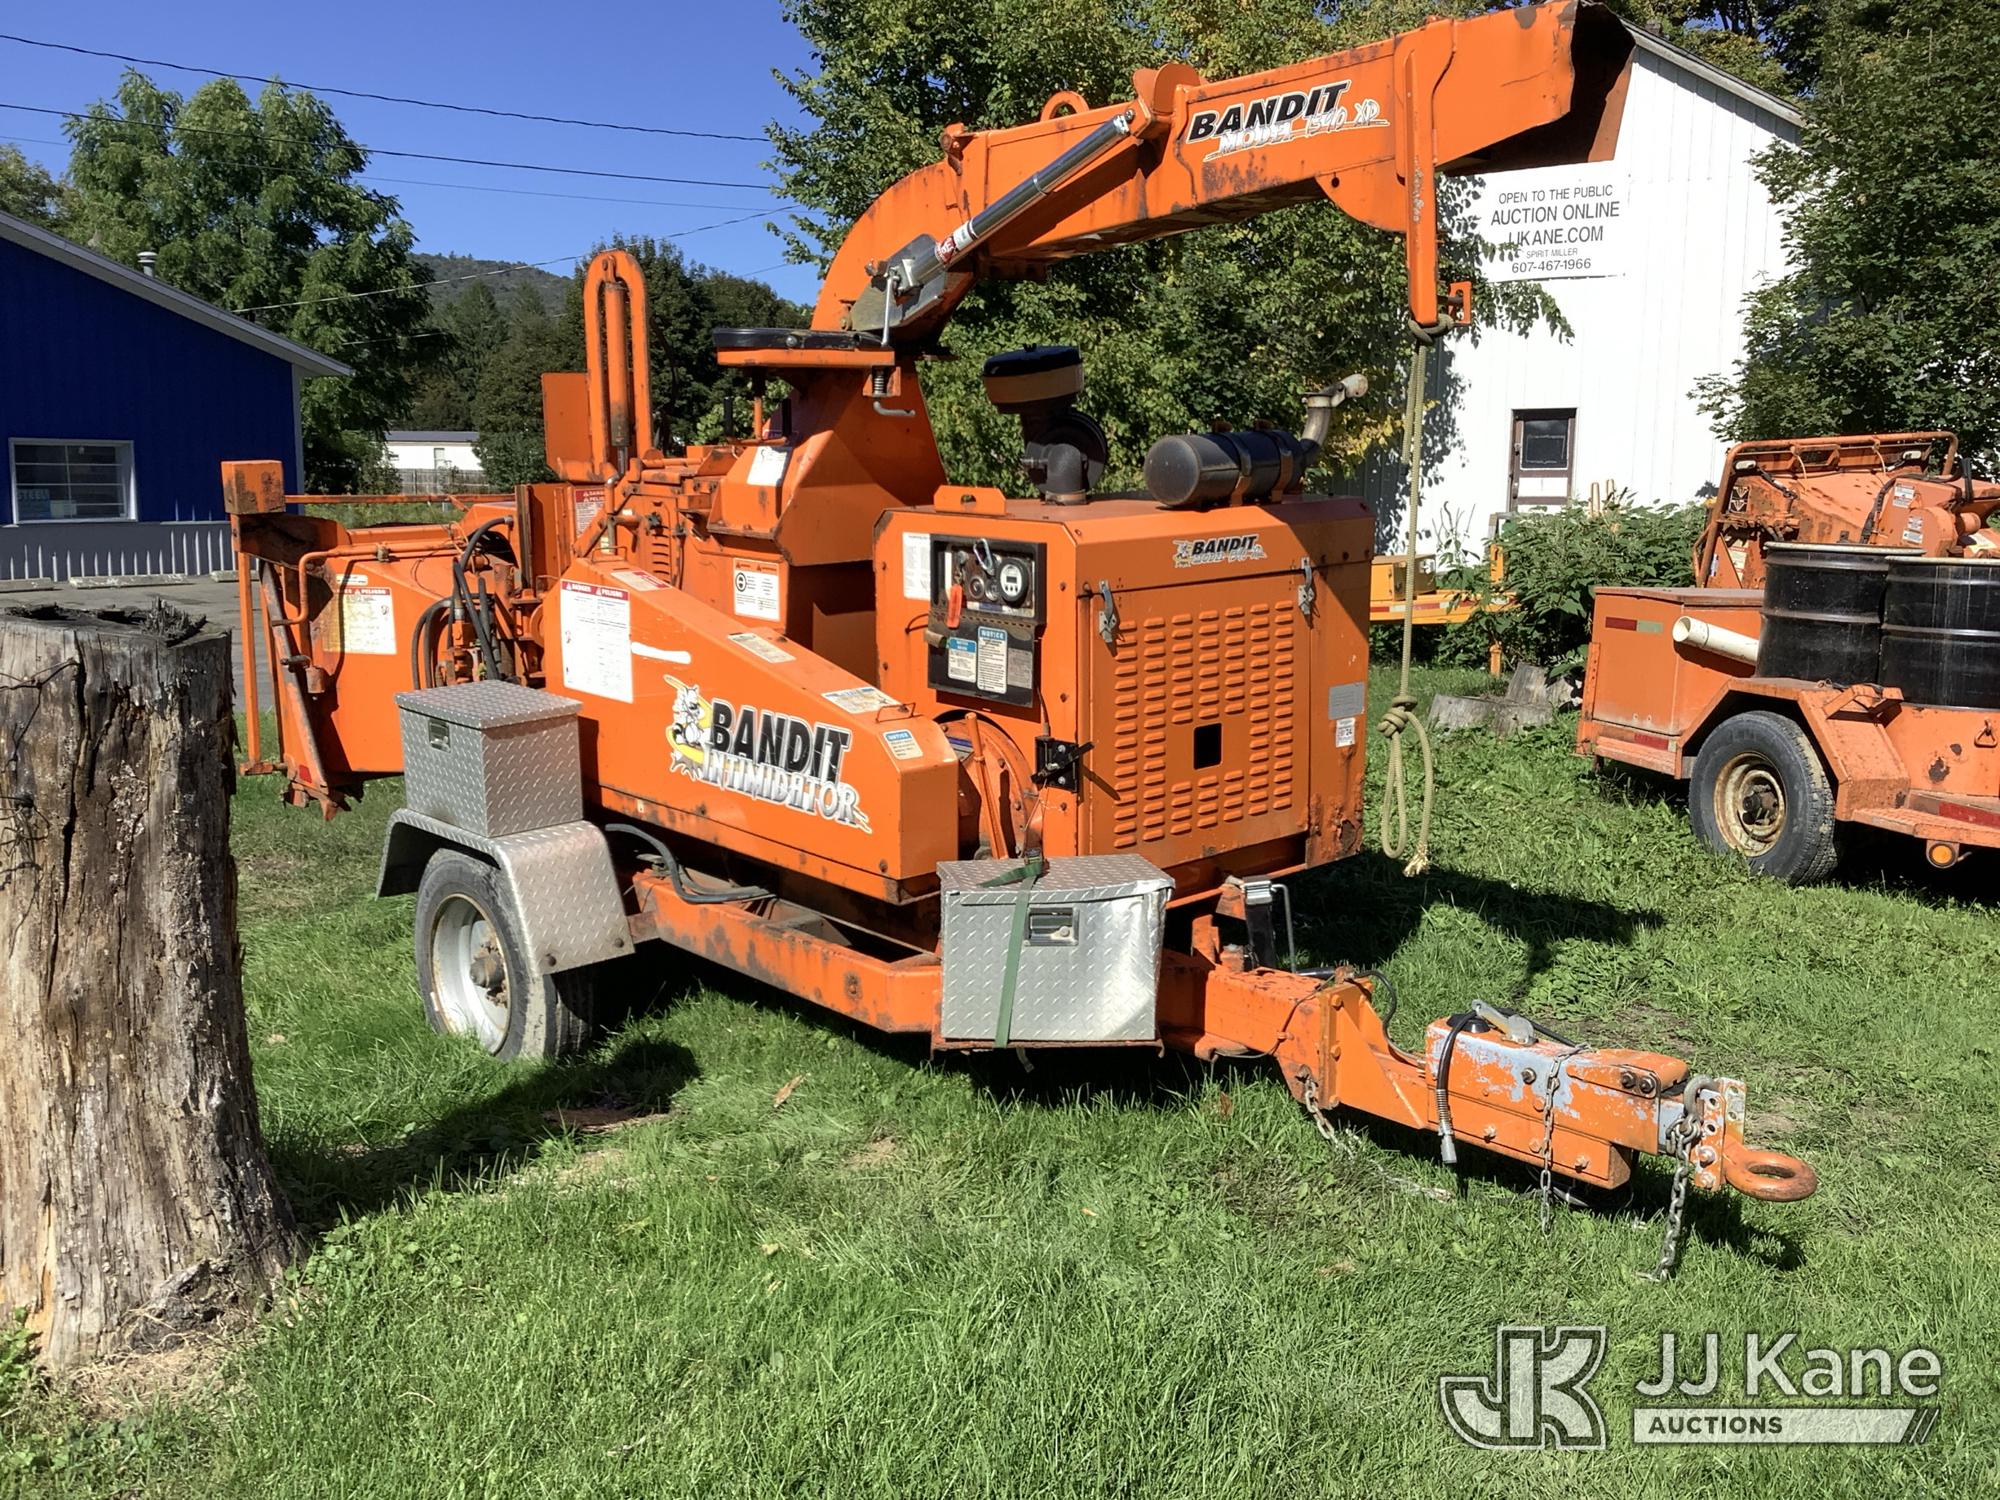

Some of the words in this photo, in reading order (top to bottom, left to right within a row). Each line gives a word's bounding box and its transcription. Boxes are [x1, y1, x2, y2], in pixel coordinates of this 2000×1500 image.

[1187, 81, 1350, 142] BANDIT
[1498, 191, 1528, 205] OPEN
[1531, 189, 1546, 202] TO
[1549, 187, 1570, 201] THE
[1573, 184, 1614, 199] PUBLIC
[1490, 205, 1558, 226] AUCTION
[1562, 200, 1620, 221] ONLINE
[1526, 249, 1549, 259] SPIRIT
[1550, 247, 1578, 257] MILLER
[1511, 257, 1592, 274] 607-467-1966
[1191, 535, 1258, 556] BANDIT
[711, 699, 851, 786] BANDIT
[702, 750, 864, 828] INTIMIDATOR
